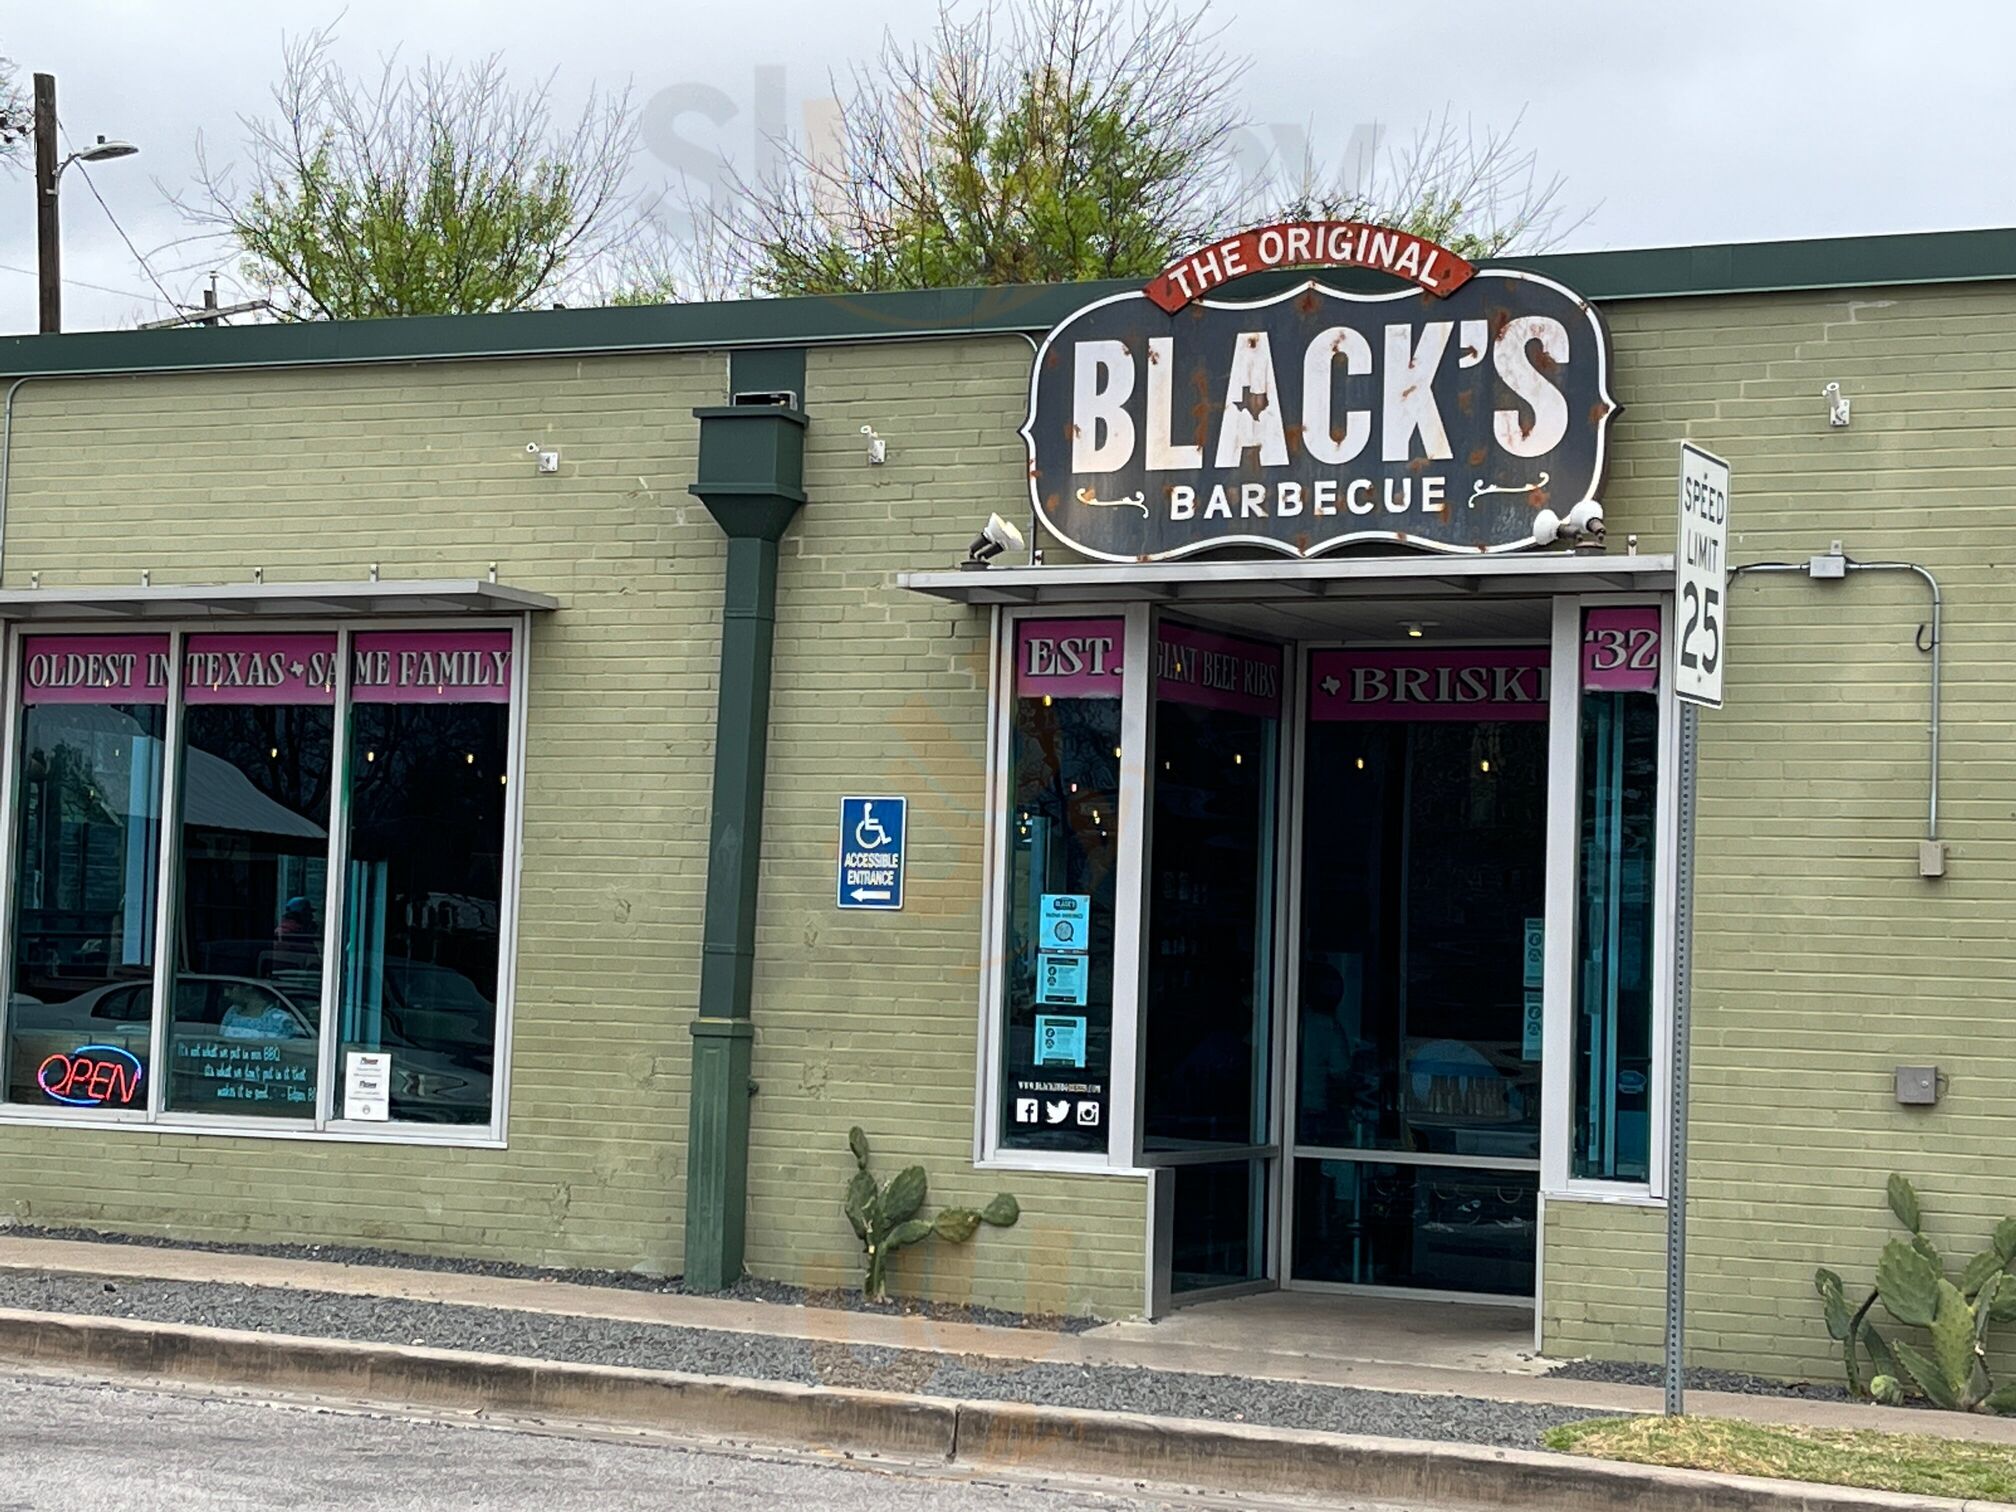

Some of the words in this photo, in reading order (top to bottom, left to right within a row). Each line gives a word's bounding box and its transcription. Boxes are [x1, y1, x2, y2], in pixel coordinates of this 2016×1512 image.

[1168, 240, 1248, 298] THE
[1257, 226, 1441, 288] ORIGINAL
[1071, 315, 1571, 474] BLACK'S
[1170, 476, 1446, 521] BARBECUE
[1684, 475, 1725, 526] SPEED
[1687, 528, 1719, 574] LIMIT
[1680, 580, 1720, 675] 25
[28, 652, 137, 688] OLDEST
[187, 652, 286, 687] TEXAS
[398, 650, 512, 686] FAMILY
[1026, 637, 1124, 676] EST.
[1203, 651, 1239, 692] BEEF
[1243, 659, 1278, 699] RIBS
[844, 852, 899, 869] ACCESSIBLE
[847, 870, 894, 886] ENTRANCE
[37, 1053, 139, 1103] OPEN
